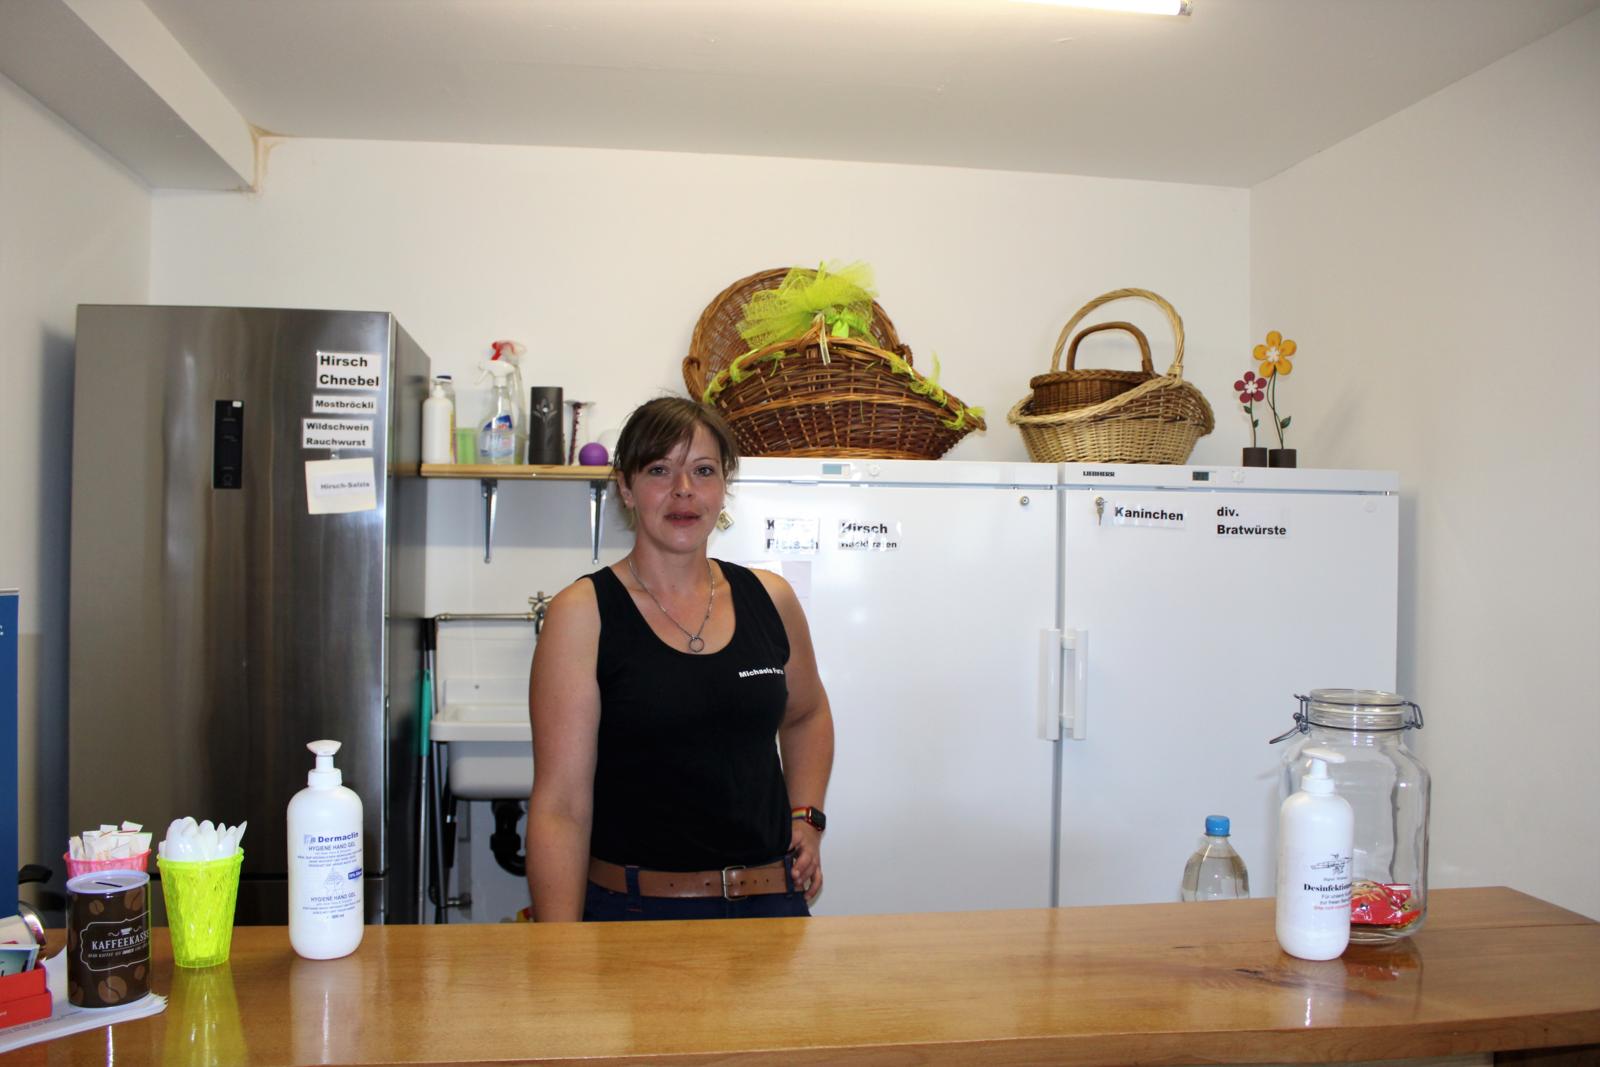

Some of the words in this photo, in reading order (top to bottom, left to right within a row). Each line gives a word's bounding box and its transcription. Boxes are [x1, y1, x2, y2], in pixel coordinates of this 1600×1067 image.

[320, 355, 368, 367] Hirsch
[319, 374, 379, 386] Chnebel
[315, 400, 374, 409] Mostbröckli
[306, 422, 369, 431] Wildschwein
[306, 438, 366, 446] Rauchwurst
[1115, 507, 1184, 521] Kaninchen
[1216, 507, 1239, 517] div.
[842, 523, 888, 534] Hirsch
[1216, 525, 1287, 535] Bratwürste
